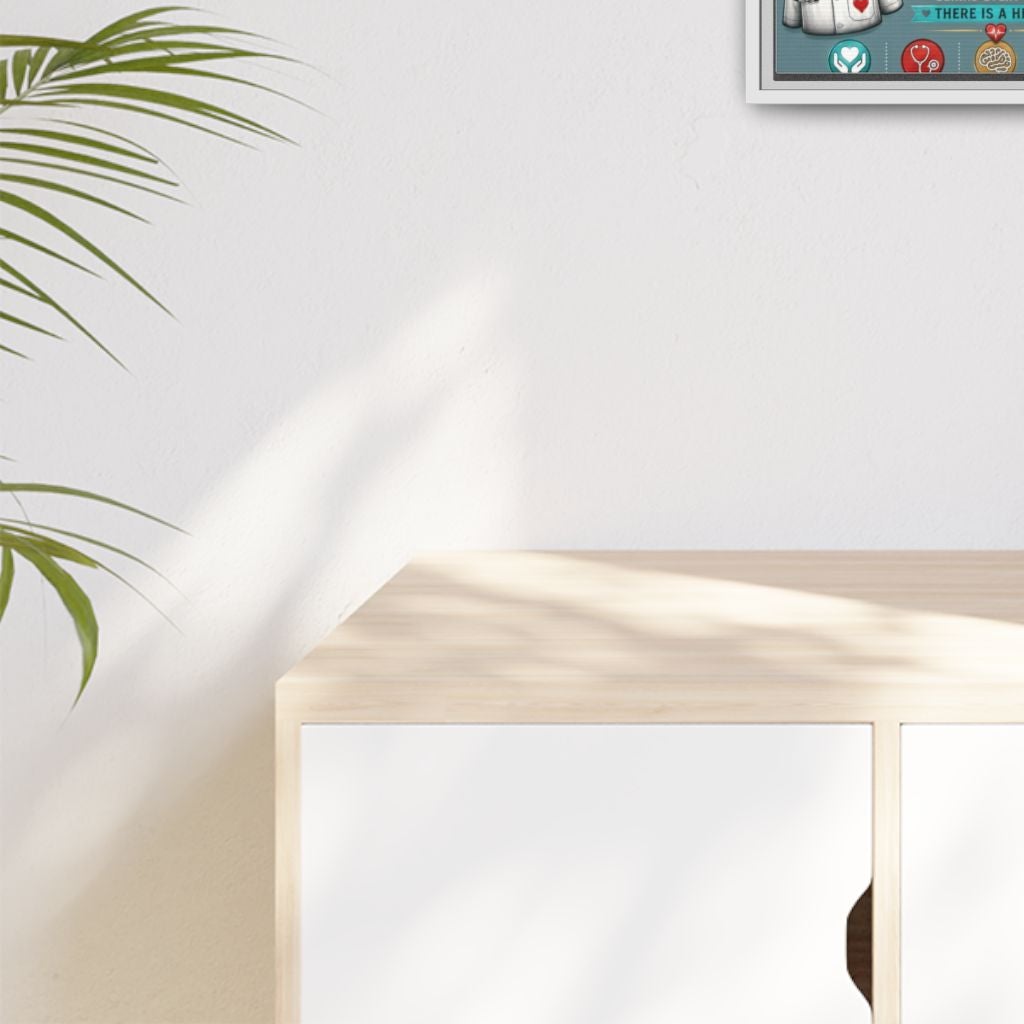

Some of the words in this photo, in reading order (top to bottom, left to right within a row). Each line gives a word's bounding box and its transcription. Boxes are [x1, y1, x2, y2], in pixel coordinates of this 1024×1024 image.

[935, 8, 976, 19] THERE
[982, 8, 993, 19] IS
[998, 8, 1007, 19] A
